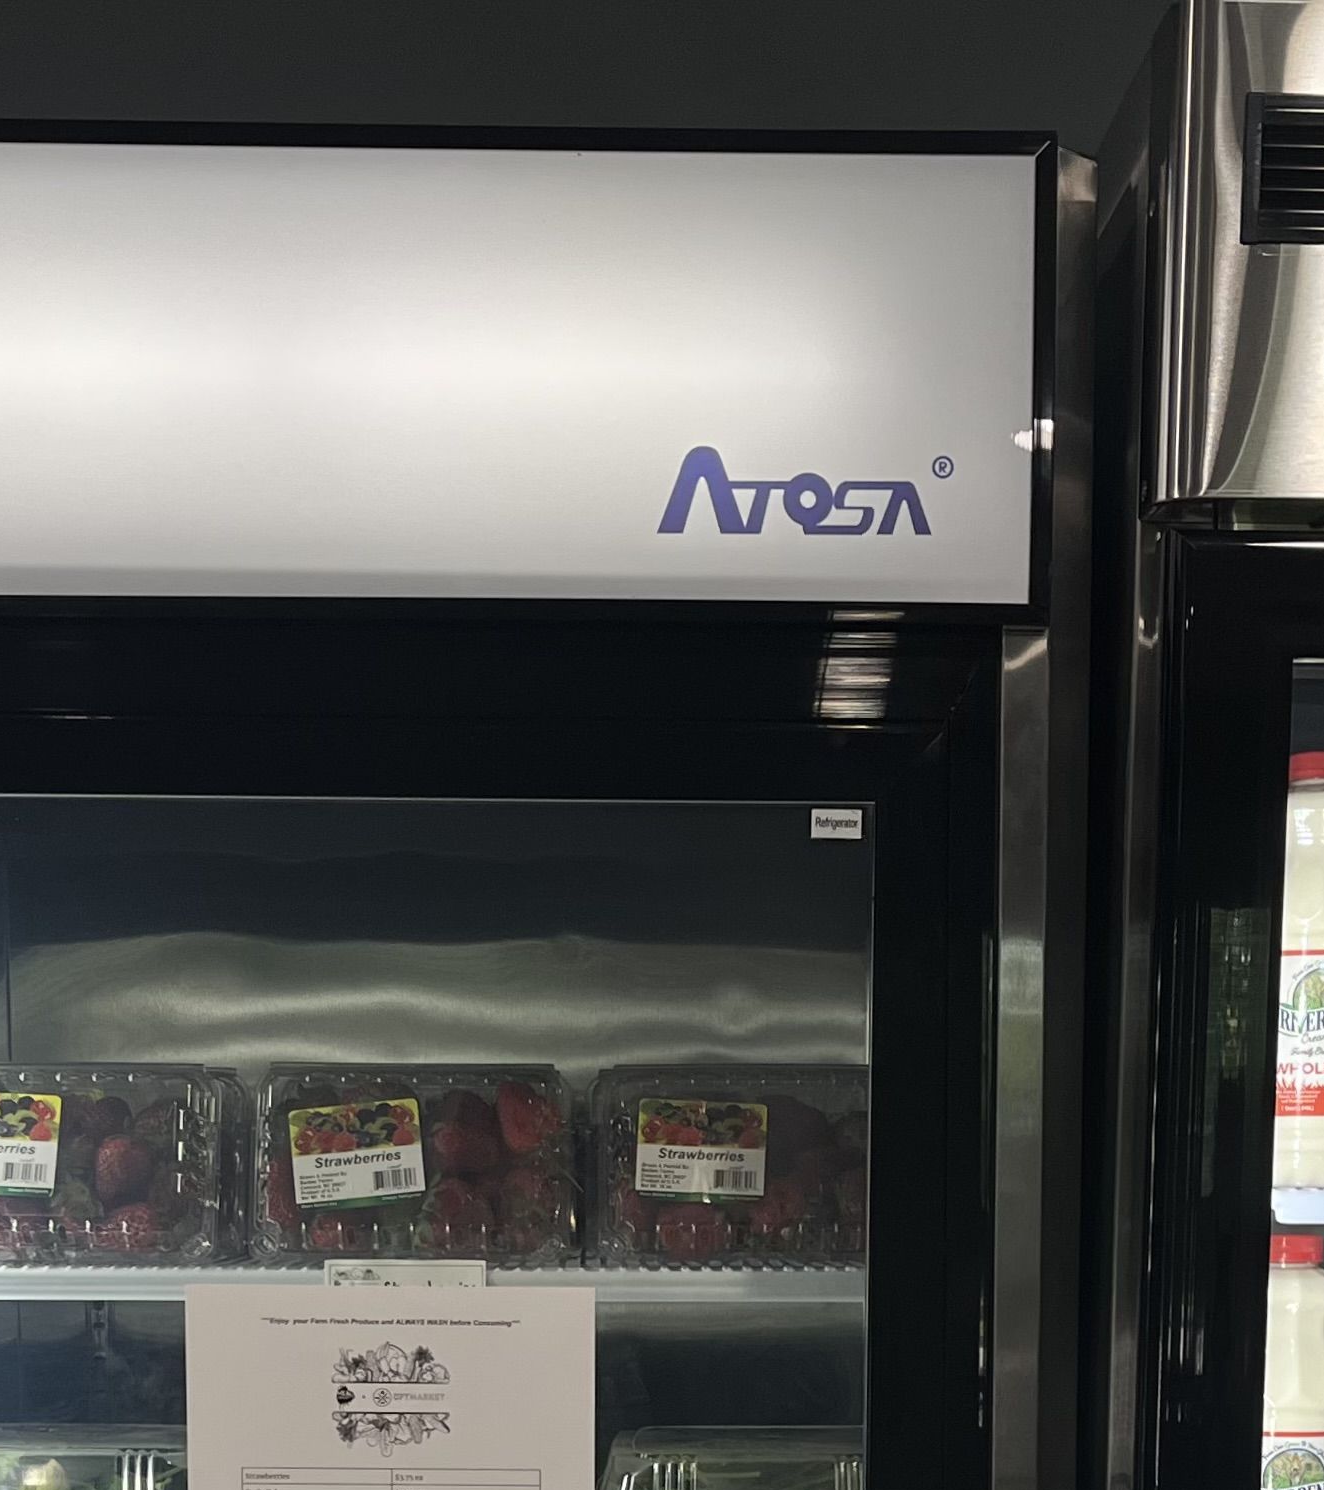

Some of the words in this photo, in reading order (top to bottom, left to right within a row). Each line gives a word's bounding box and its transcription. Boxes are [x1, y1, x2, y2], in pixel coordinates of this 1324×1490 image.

[657, 446, 931, 535] ATOSA
[816, 816, 858, 830] Refrigerator
[315, 1150, 401, 1168] Strawberries
[658, 1148, 745, 1162] Strawberries
